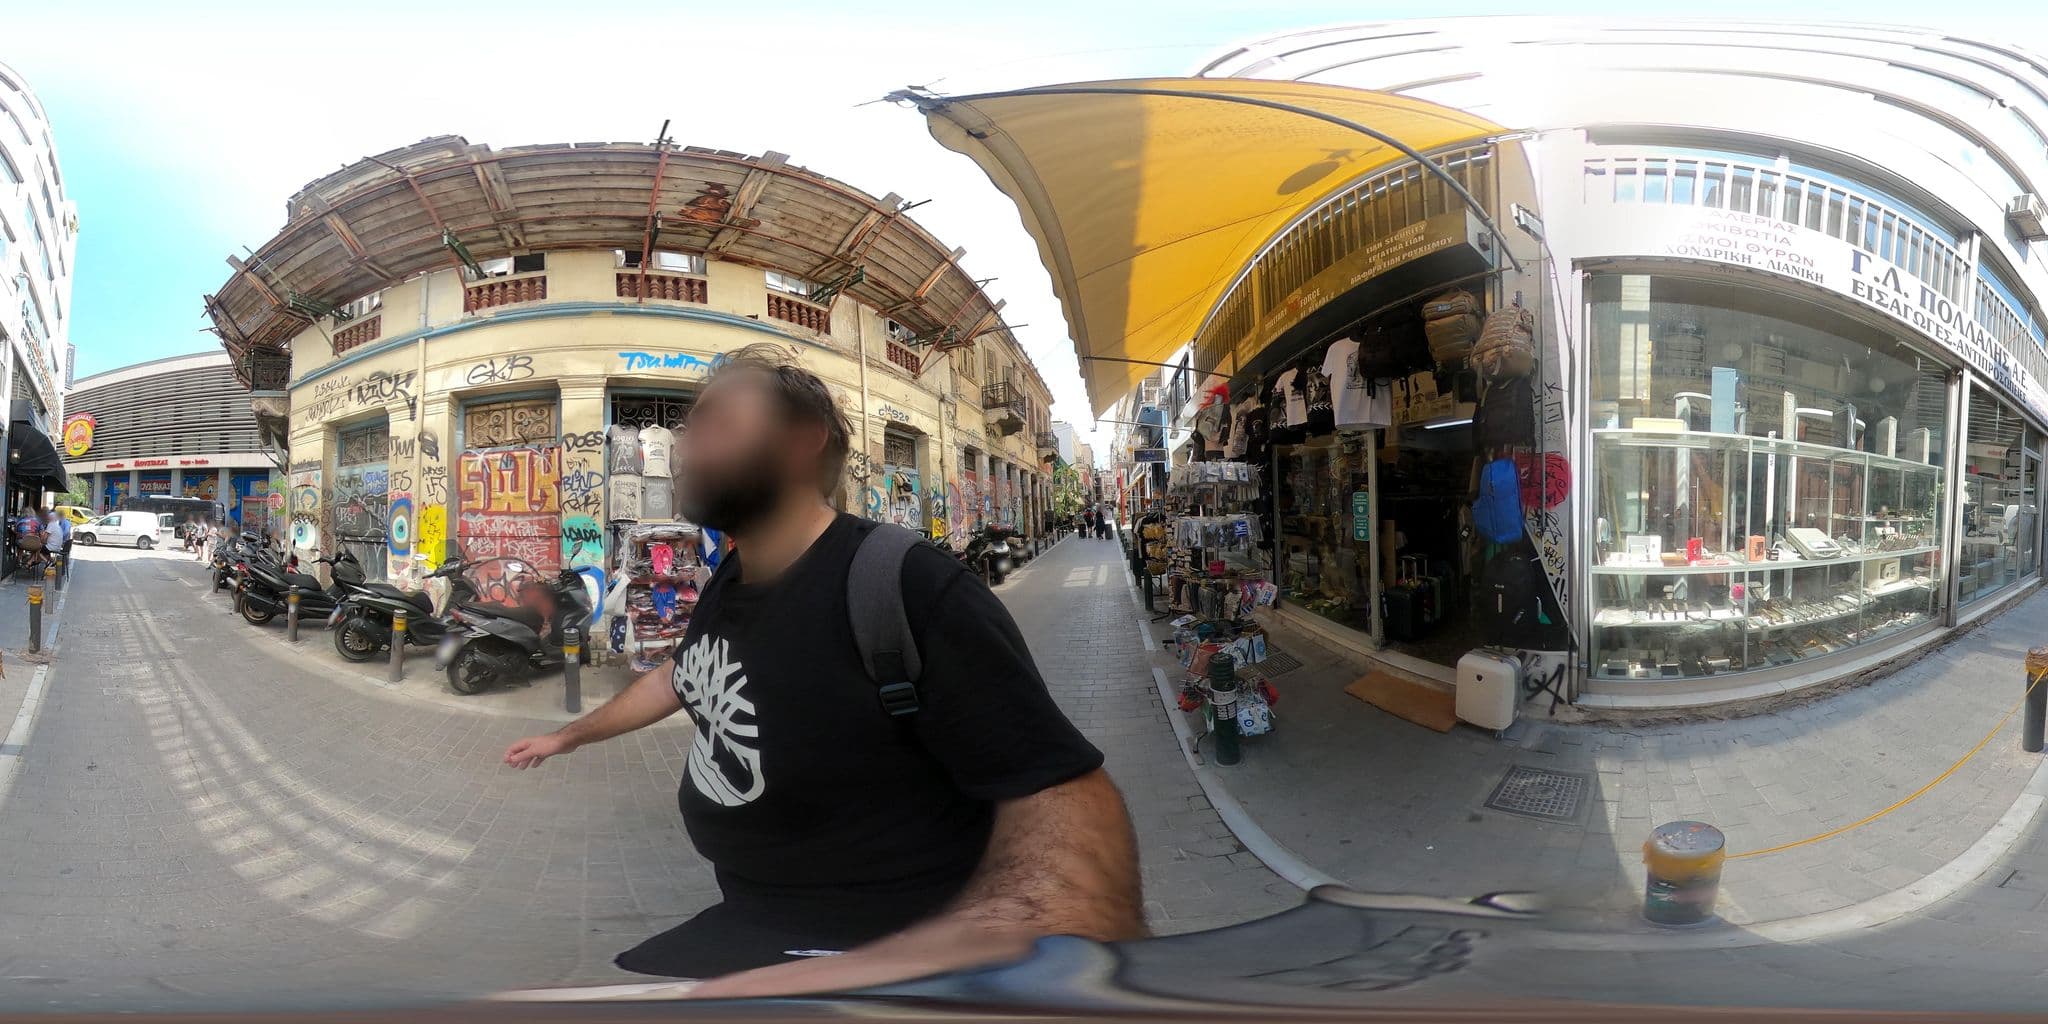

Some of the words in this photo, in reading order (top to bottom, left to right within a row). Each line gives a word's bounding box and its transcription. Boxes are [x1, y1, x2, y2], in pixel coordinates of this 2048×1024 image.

[1746, 243, 1815, 267] ΘΥΡΩΝ
[1766, 259, 1824, 283] ΛΙΑΝΙΚΗ
[1299, 287, 1321, 308] FORCE
